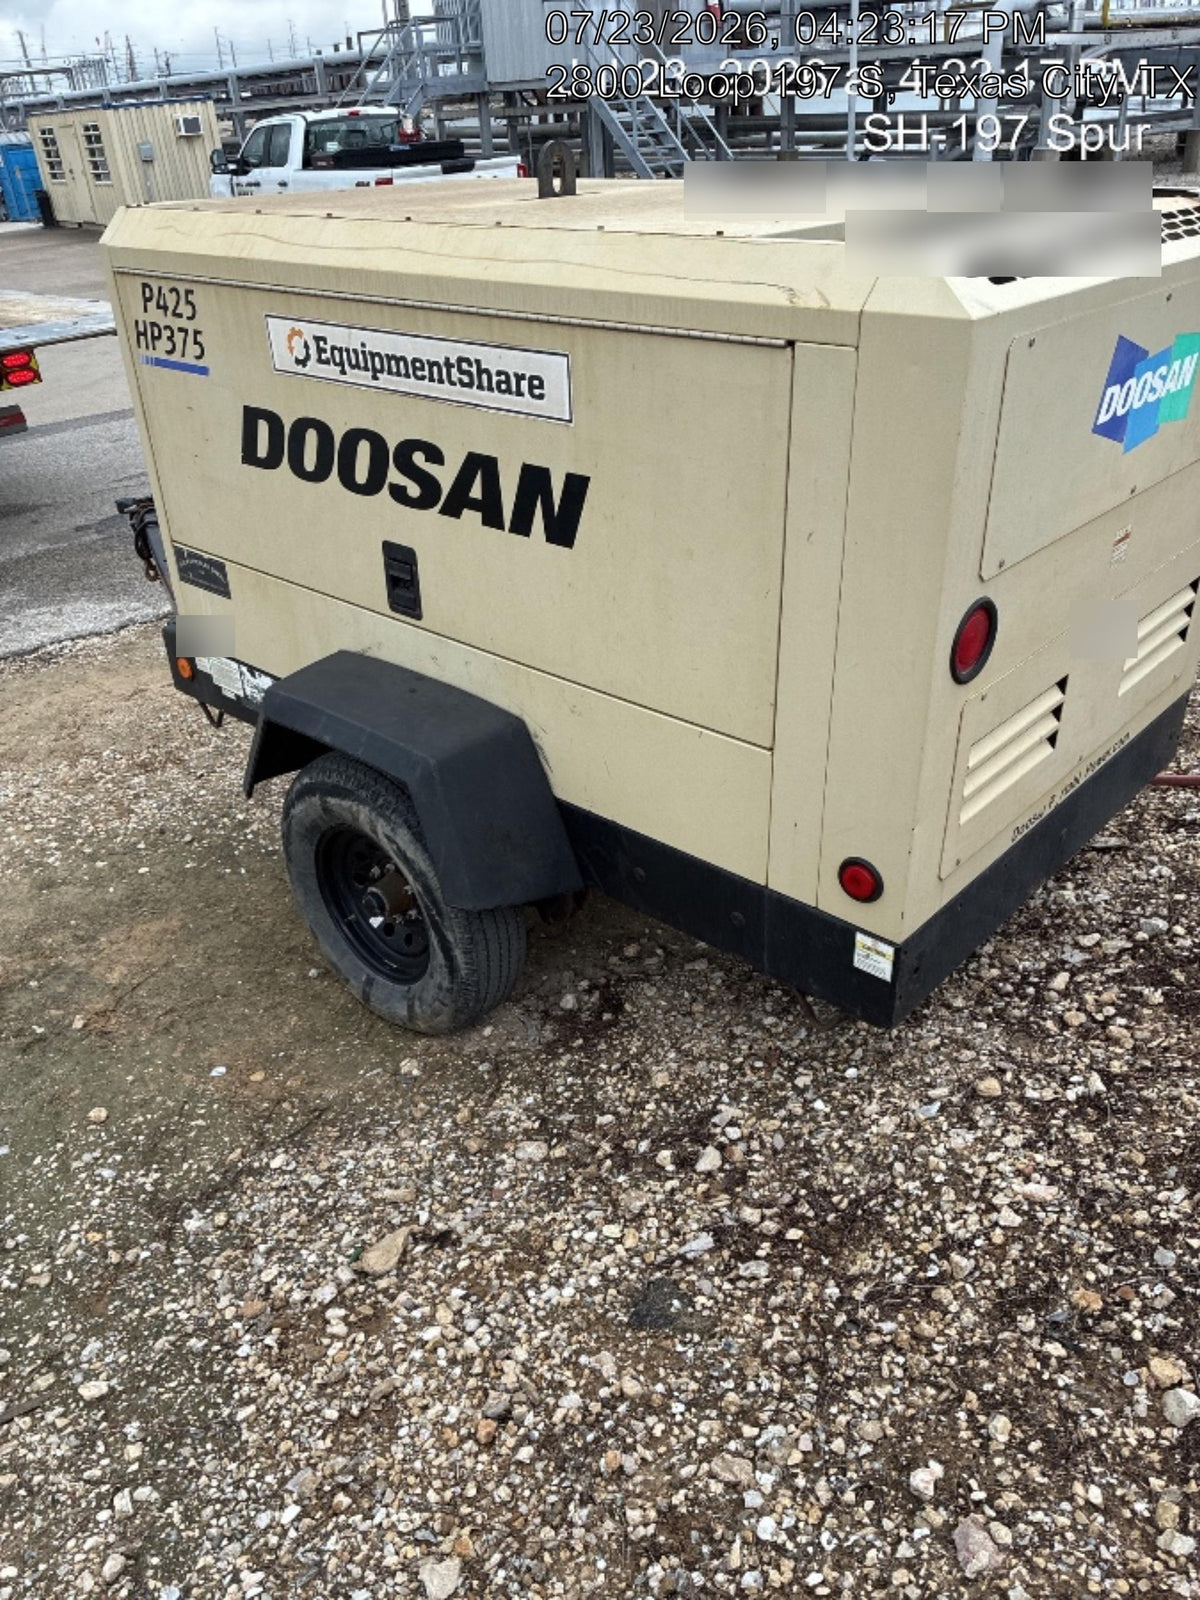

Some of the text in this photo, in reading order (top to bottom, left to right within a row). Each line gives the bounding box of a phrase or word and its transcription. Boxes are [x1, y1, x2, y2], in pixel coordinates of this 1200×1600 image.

[140, 282, 198, 321] P425
[134, 319, 206, 360] HP375
[311, 334, 546, 402] EquipmentShare
[1096, 351, 1199, 427] DOOSAN
[241, 404, 592, 549] DOOSAN
